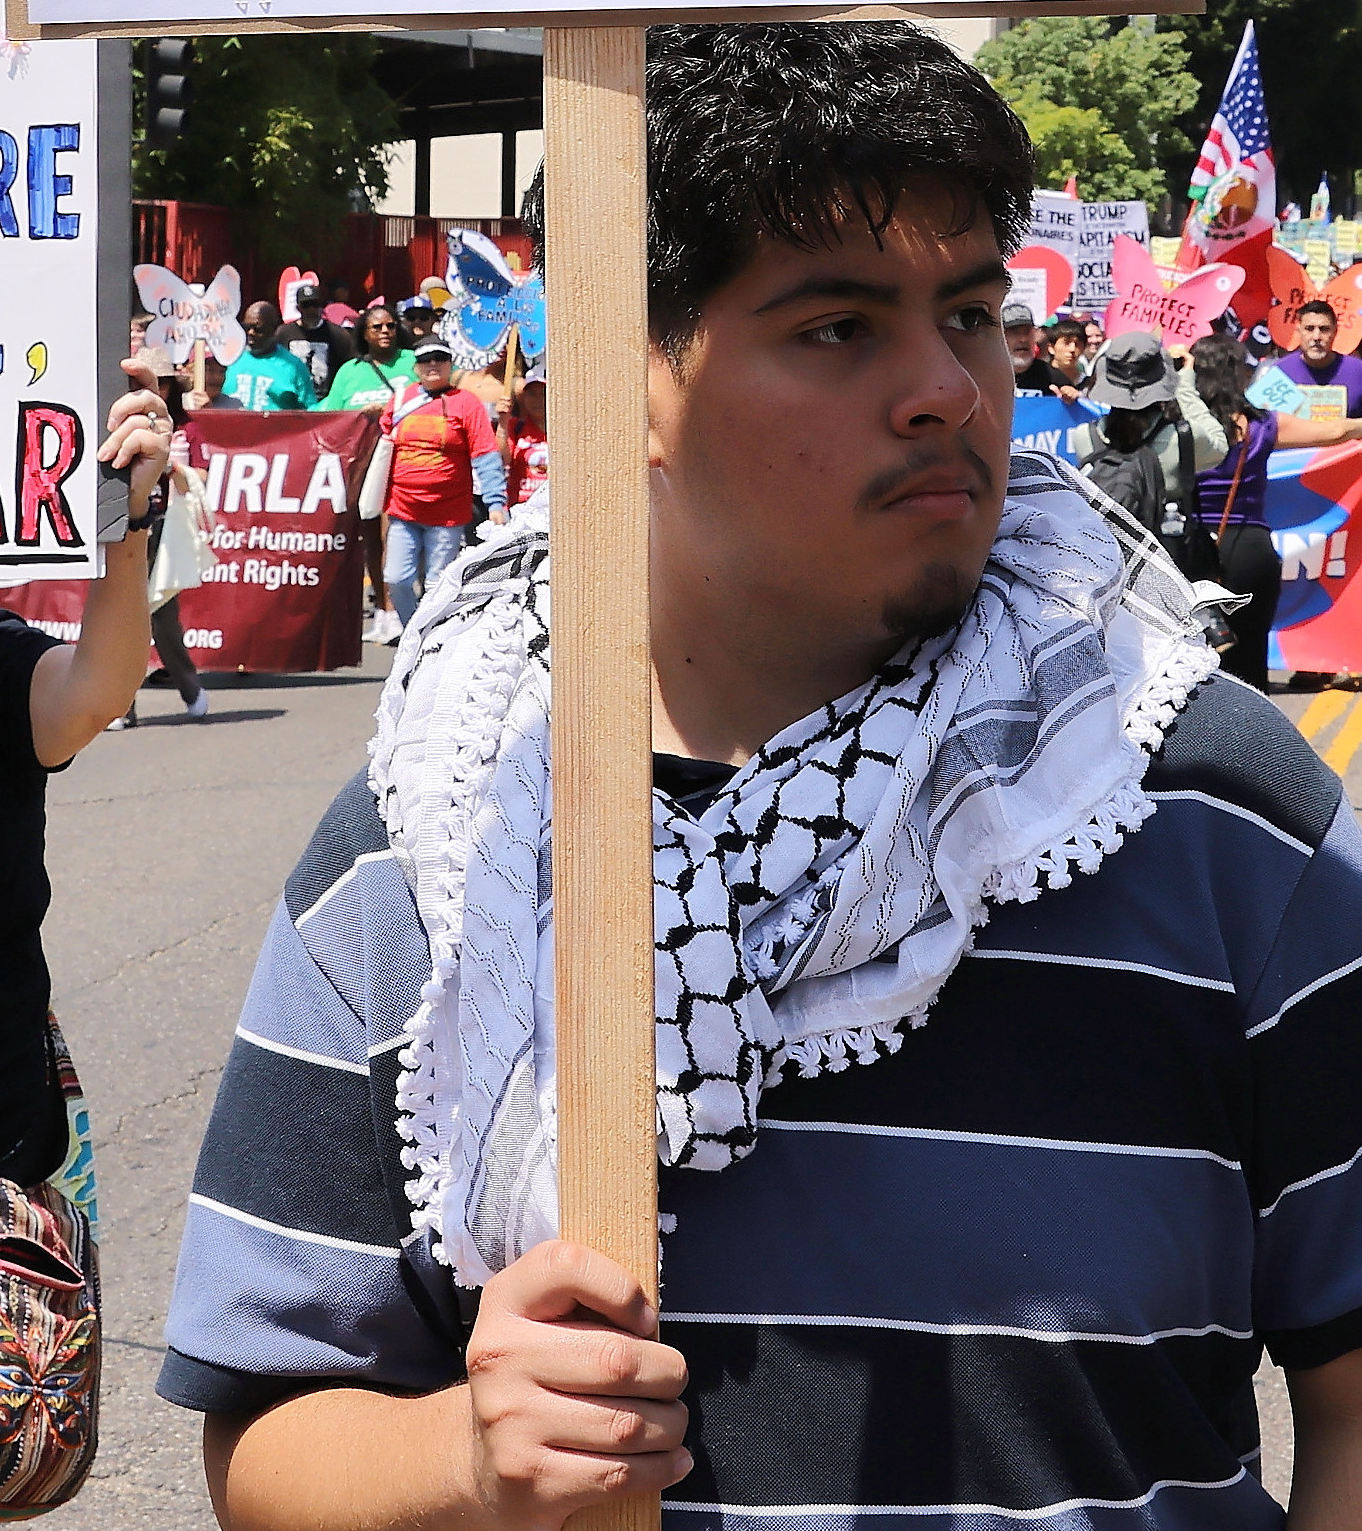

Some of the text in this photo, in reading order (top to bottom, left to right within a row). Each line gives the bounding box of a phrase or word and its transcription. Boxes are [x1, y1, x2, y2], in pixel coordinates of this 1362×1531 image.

[1049, 211, 1075, 227] THE
[1082, 205, 1127, 221] TRUMP
[1091, 281, 1114, 295] THE
[1132, 284, 1195, 317] PROTECT
[1122, 302, 1197, 338] FAMILIES
[1262, 388, 1289, 407] OUT
[1272, 379, 1296, 398] ICE
[1014, 429, 1062, 455] MAY
[205, 453, 348, 514] IRLA
[212, 525, 246, 550] for
[248, 526, 347, 553] Humane
[243, 561, 320, 591] Rights
